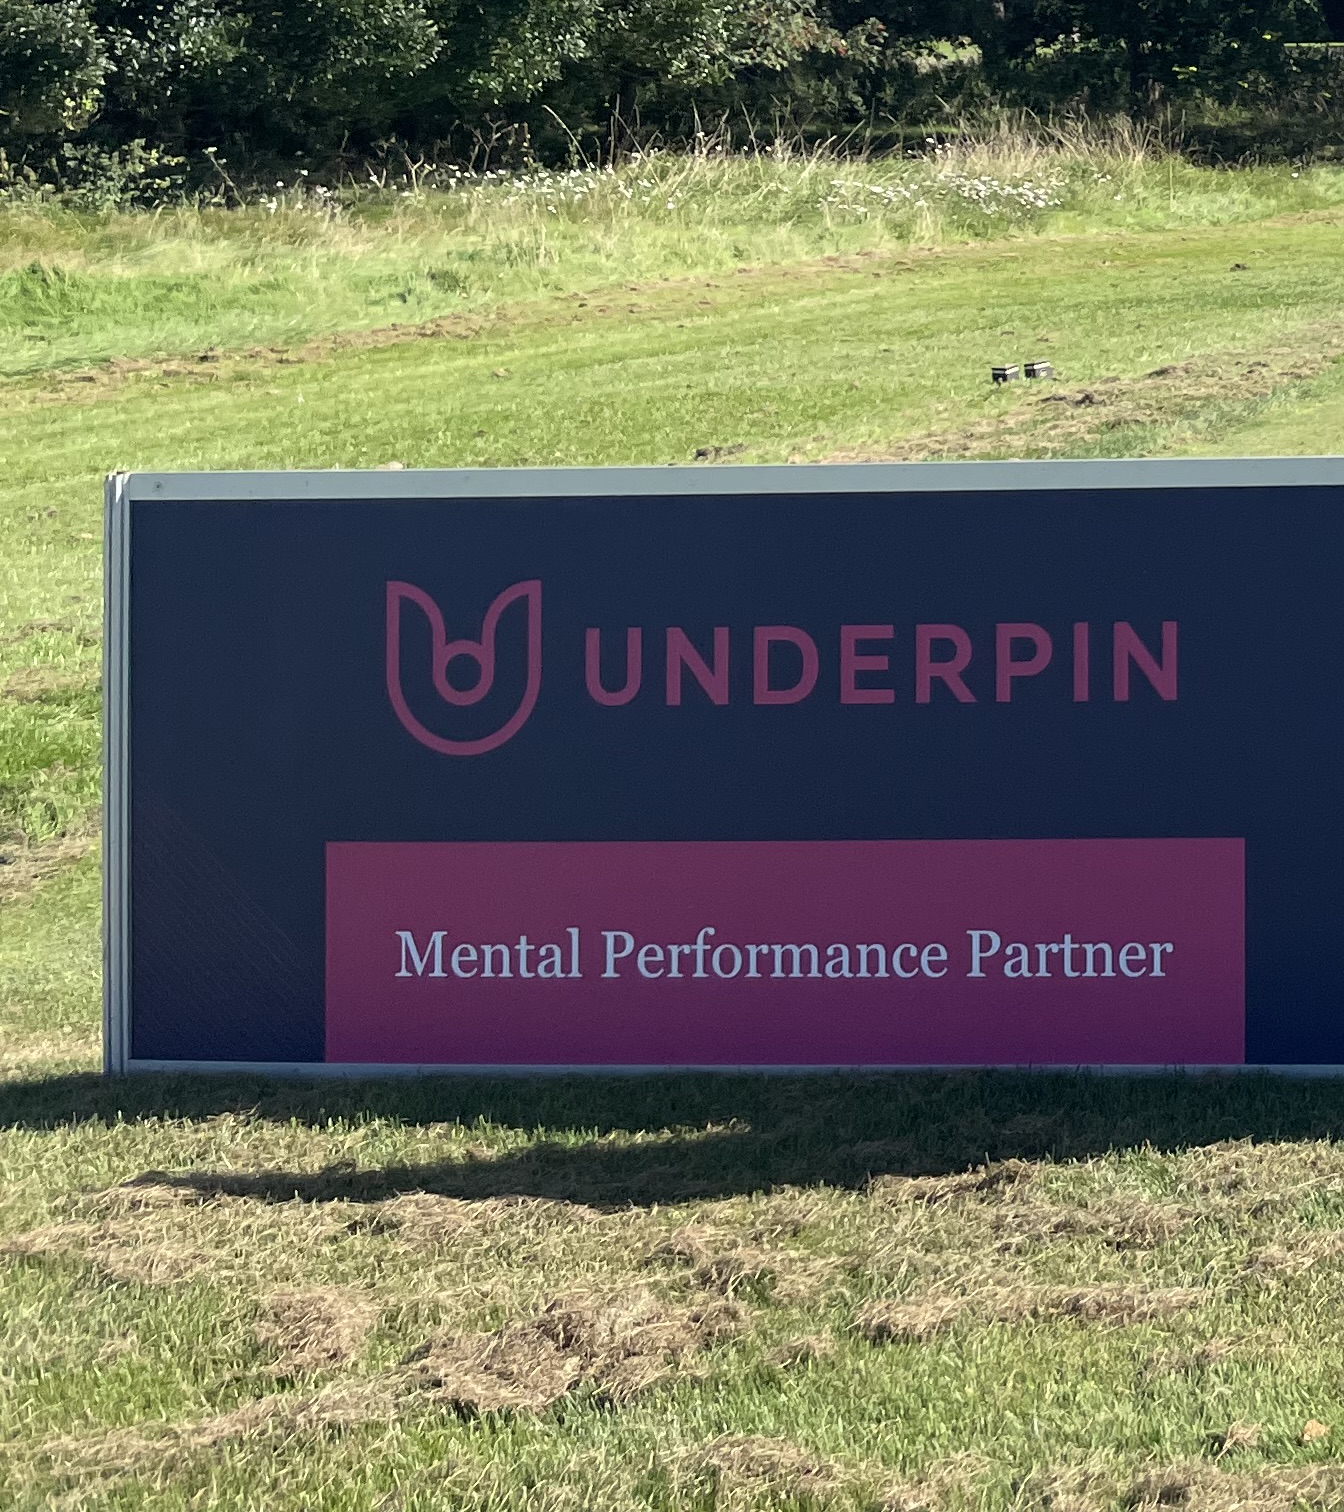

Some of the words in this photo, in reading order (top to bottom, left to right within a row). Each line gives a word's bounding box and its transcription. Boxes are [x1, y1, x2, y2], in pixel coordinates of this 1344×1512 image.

[586, 622, 1177, 705] UNDERPIN
[395, 928, 582, 977] Mental
[601, 928, 947, 978] Performance
[967, 931, 1173, 977] Partner
